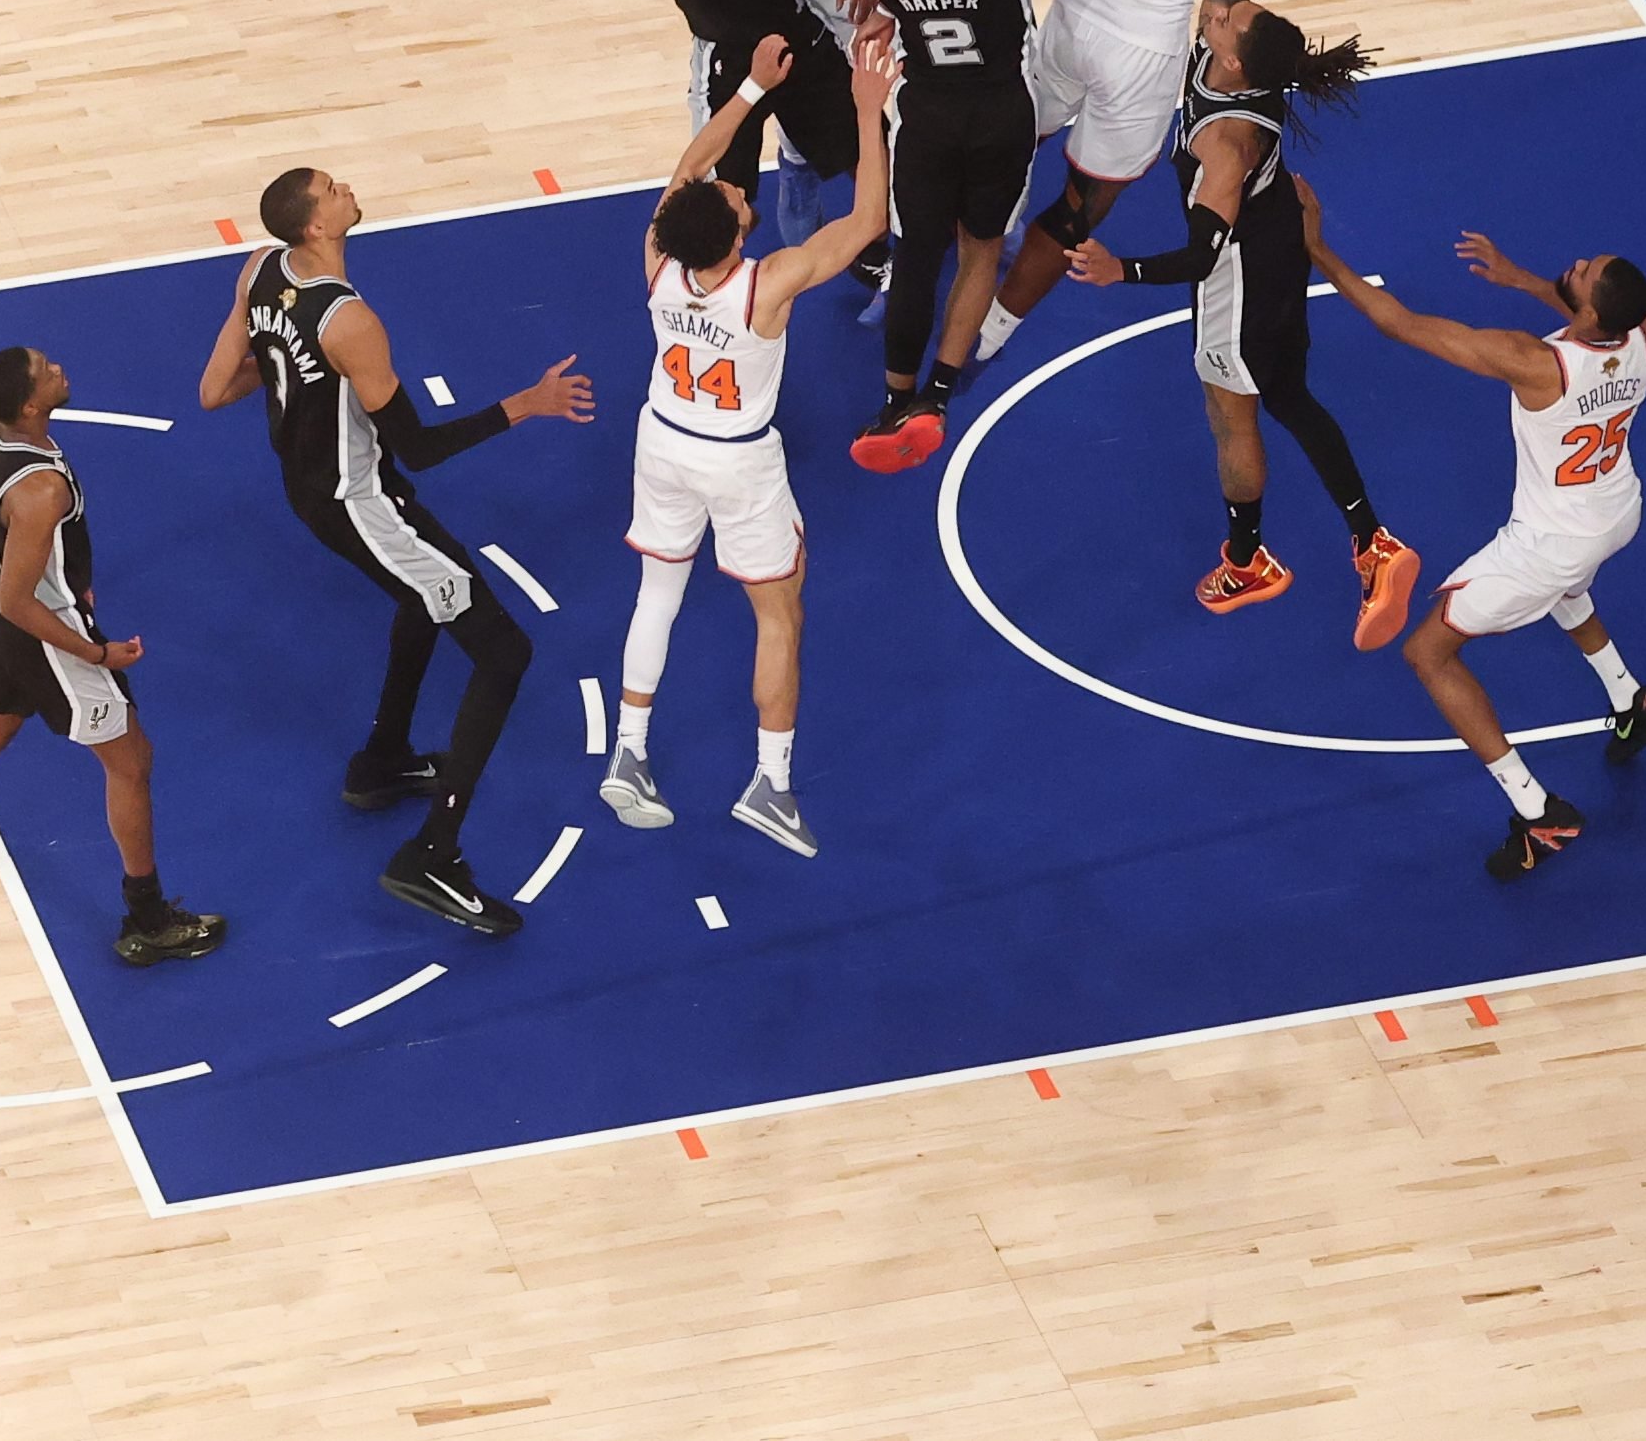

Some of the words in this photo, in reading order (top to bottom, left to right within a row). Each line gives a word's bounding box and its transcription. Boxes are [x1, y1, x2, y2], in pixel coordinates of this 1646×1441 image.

[919, 18, 985, 67] 2
[247, 305, 326, 385] MBANYAMA
[662, 310, 735, 351] SHAMET
[662, 343, 742, 411] 44
[1576, 378, 1641, 416] BRIDGES
[1554, 404, 1638, 487] 25
